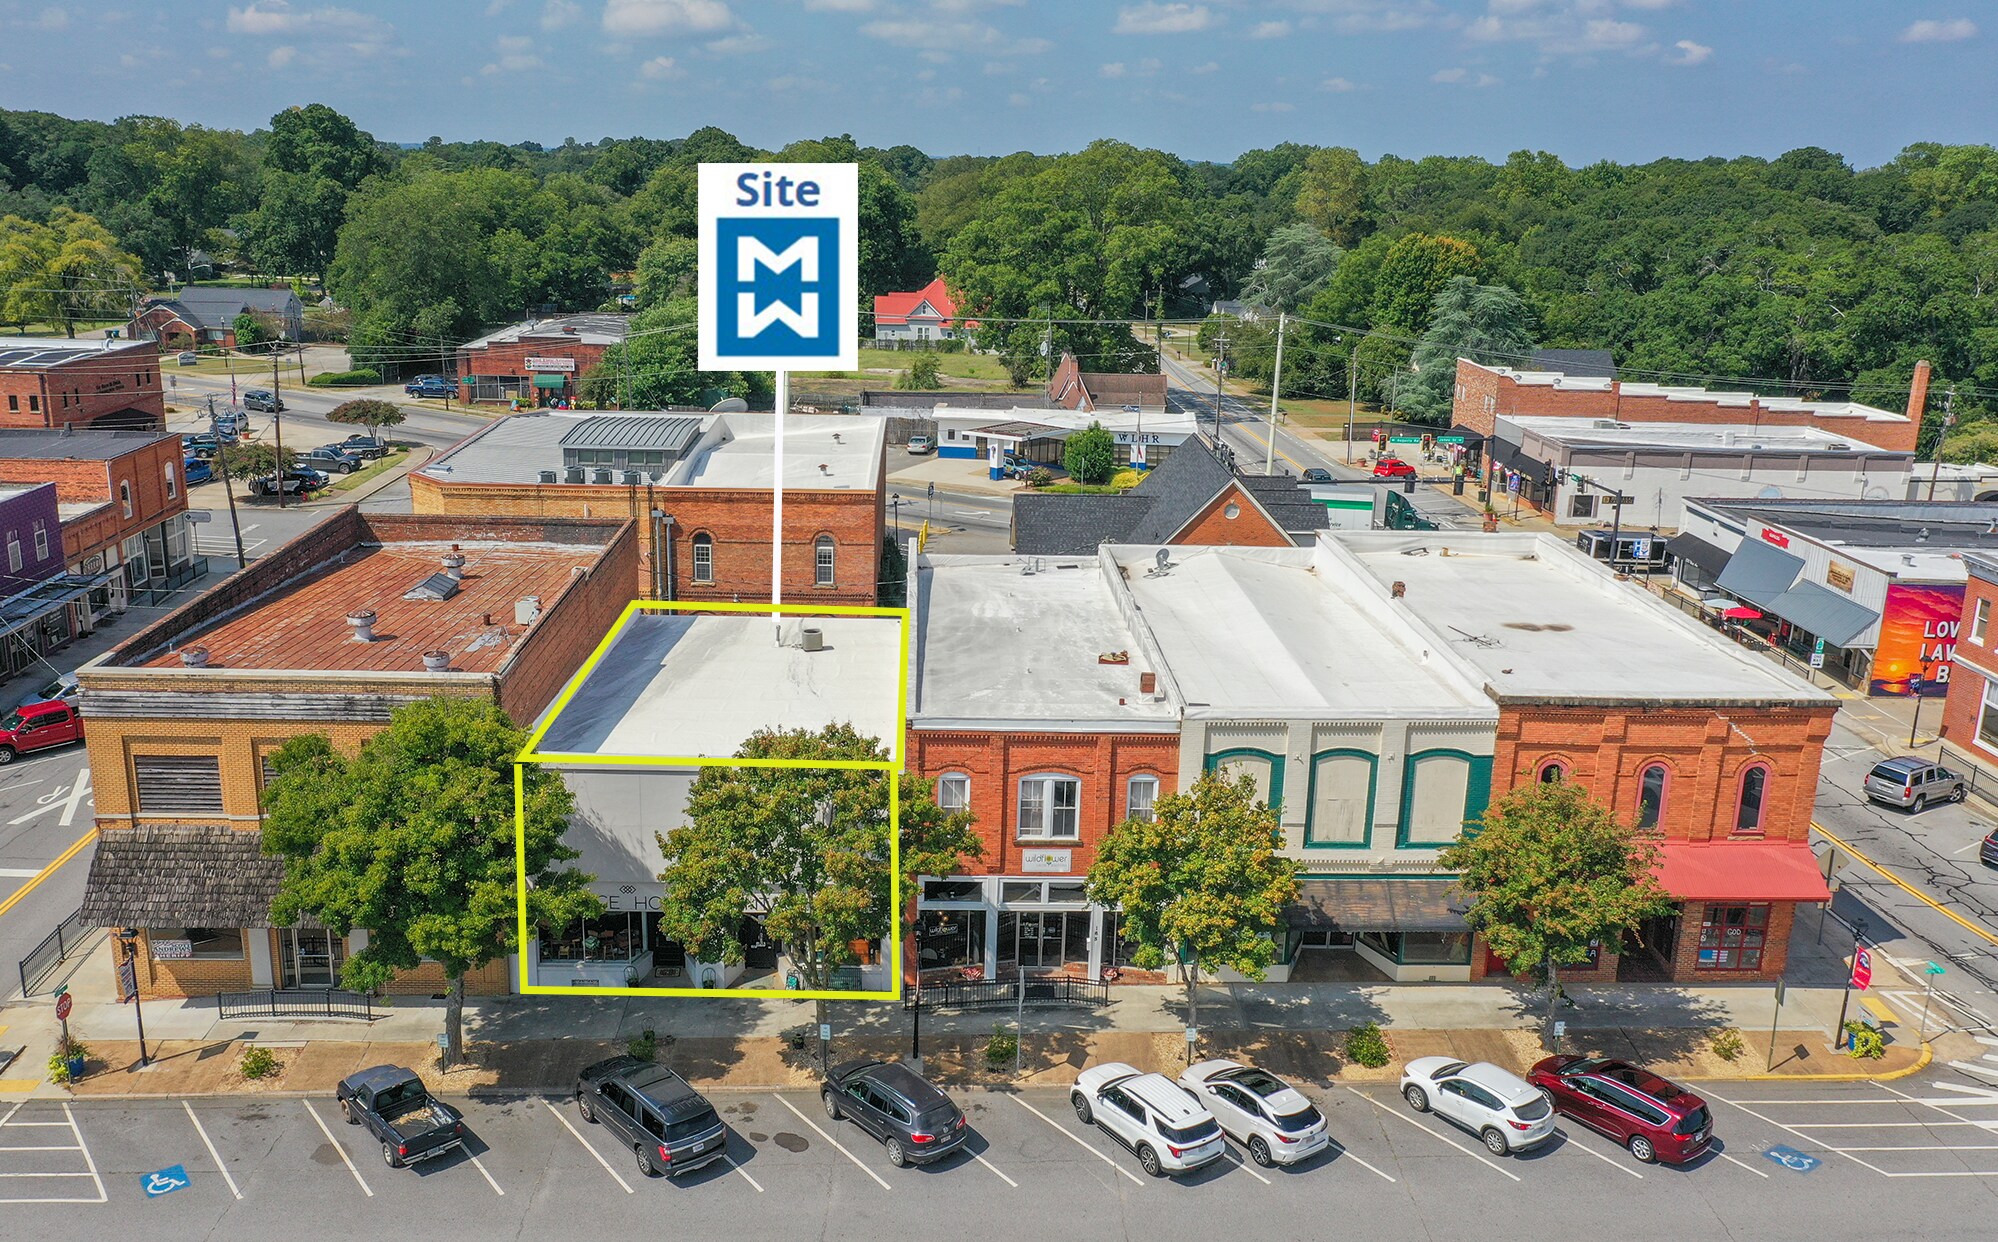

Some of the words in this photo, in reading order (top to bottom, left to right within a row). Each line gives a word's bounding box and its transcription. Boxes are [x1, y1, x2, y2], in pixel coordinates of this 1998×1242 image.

[1923, 621, 1961, 638] LOV
[1919, 643, 1957, 661] LAV
[1935, 665, 1951, 683] B
[1025, 854, 1068, 864] wildflower
[57, 997, 71, 1016] STOP
